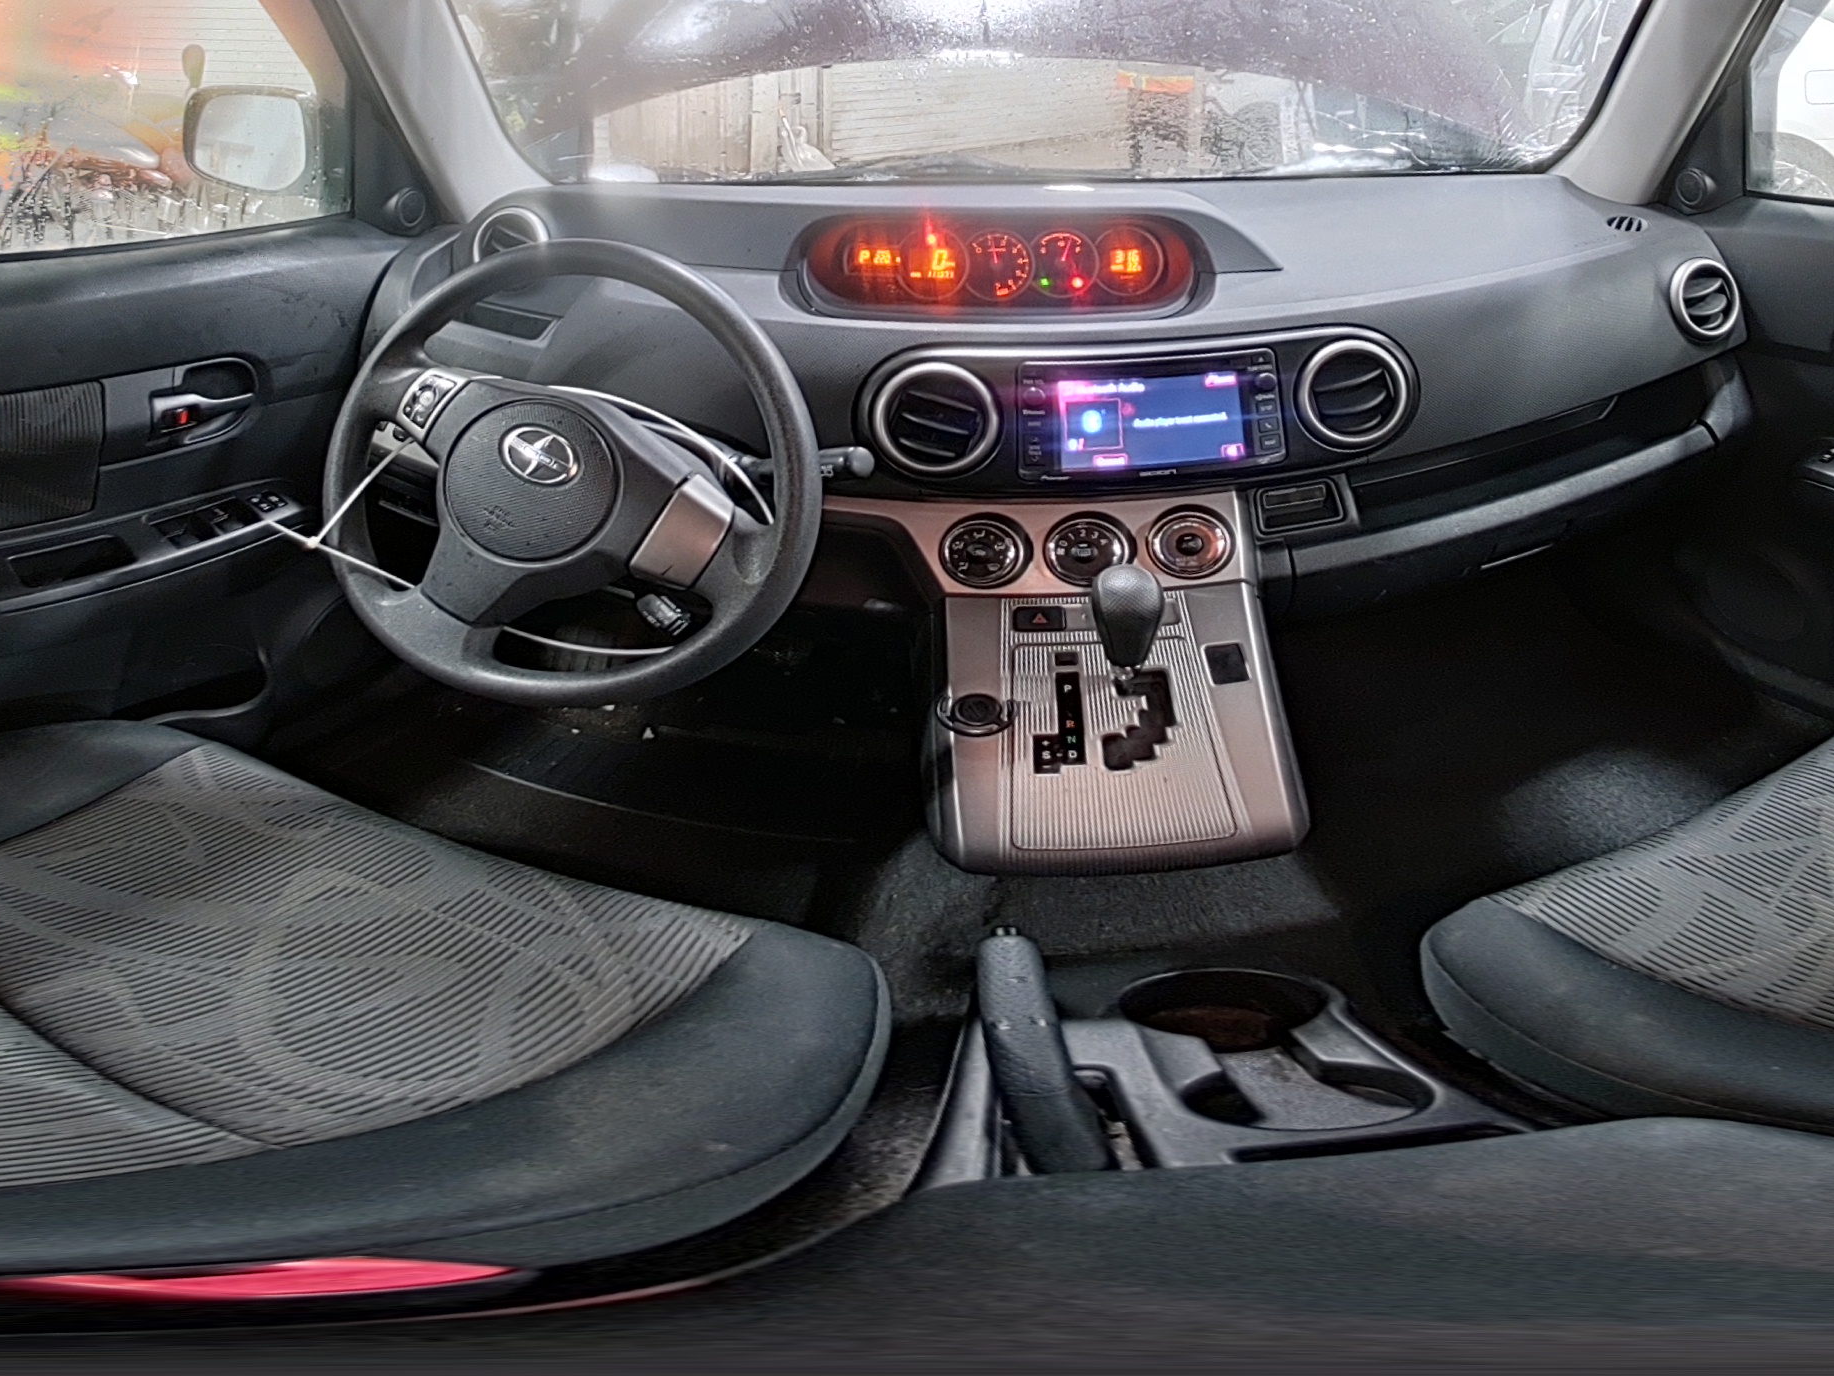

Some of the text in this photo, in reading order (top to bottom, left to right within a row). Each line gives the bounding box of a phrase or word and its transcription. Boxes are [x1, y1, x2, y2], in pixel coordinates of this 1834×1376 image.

[859, 250, 871, 264] P
[1079, 528, 1087, 538] 2
[1091, 531, 1099, 540] 3
[1063, 684, 1072, 693] P
[1065, 719, 1075, 728] R
[1066, 735, 1076, 744] N
[1041, 749, 1078, 759] S D
